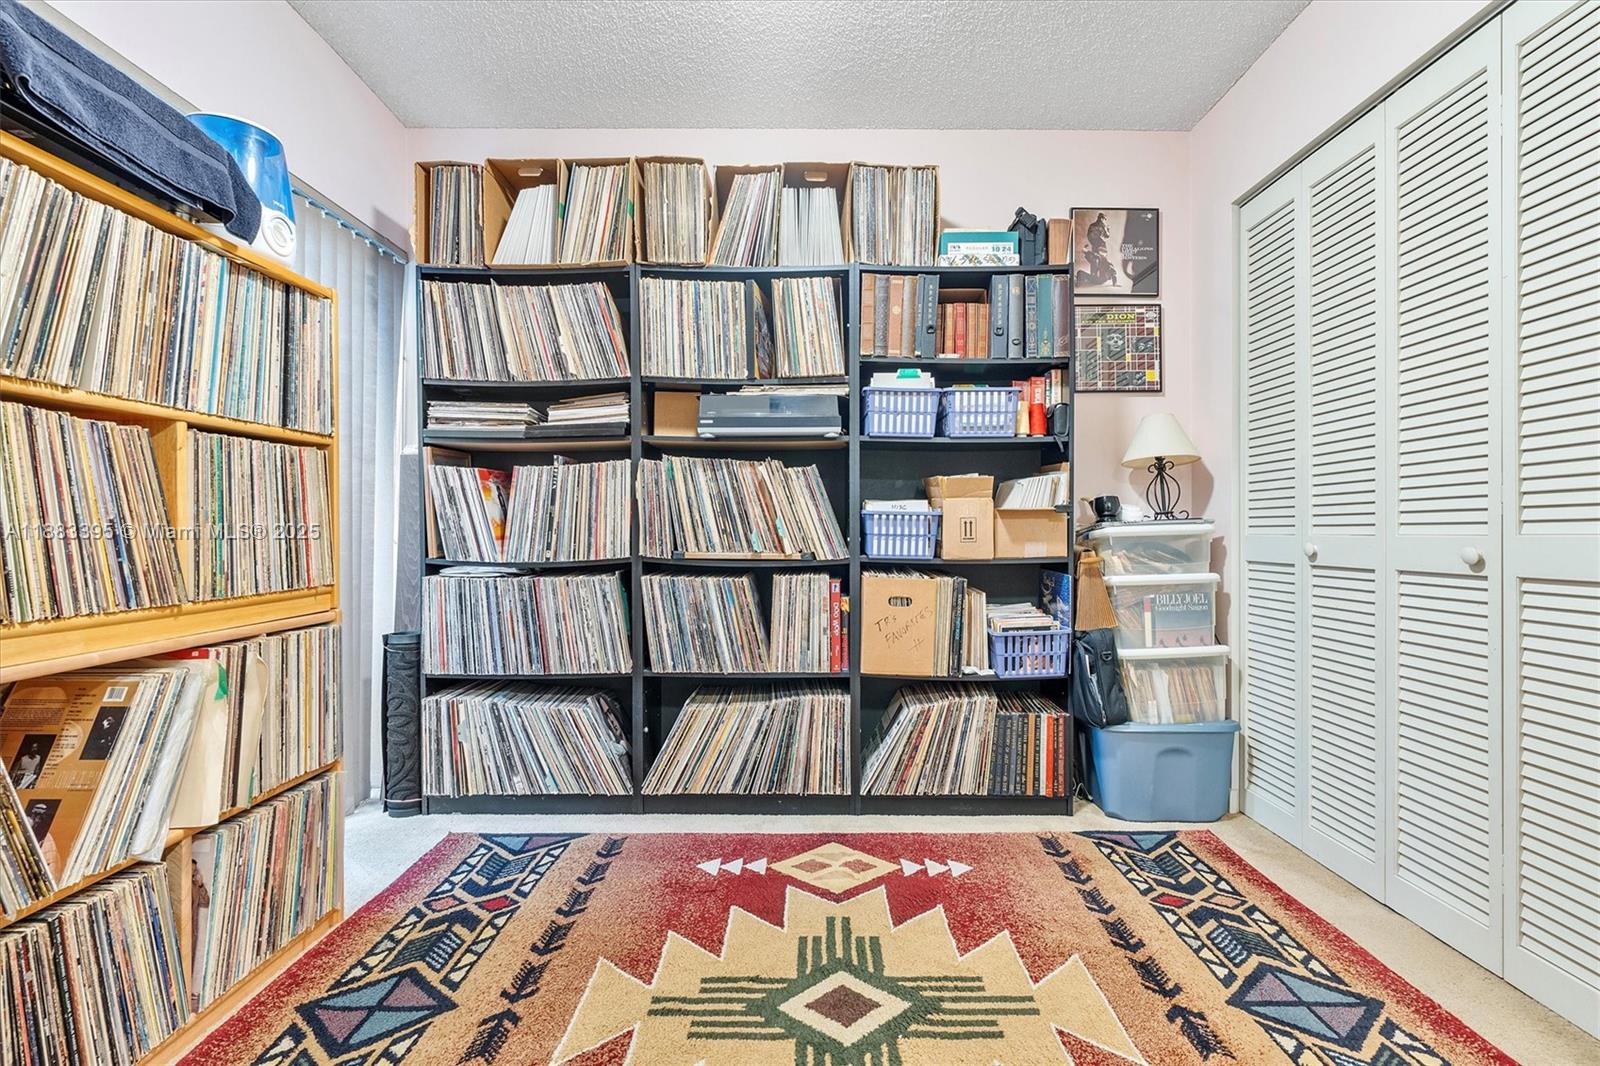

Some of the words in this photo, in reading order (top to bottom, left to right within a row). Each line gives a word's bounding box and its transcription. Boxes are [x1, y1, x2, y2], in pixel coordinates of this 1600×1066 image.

[1156, 593, 1183, 604] BILLY
[1183, 593, 1208, 604] JOEL
[884, 606, 933, 649] FAVORITES
